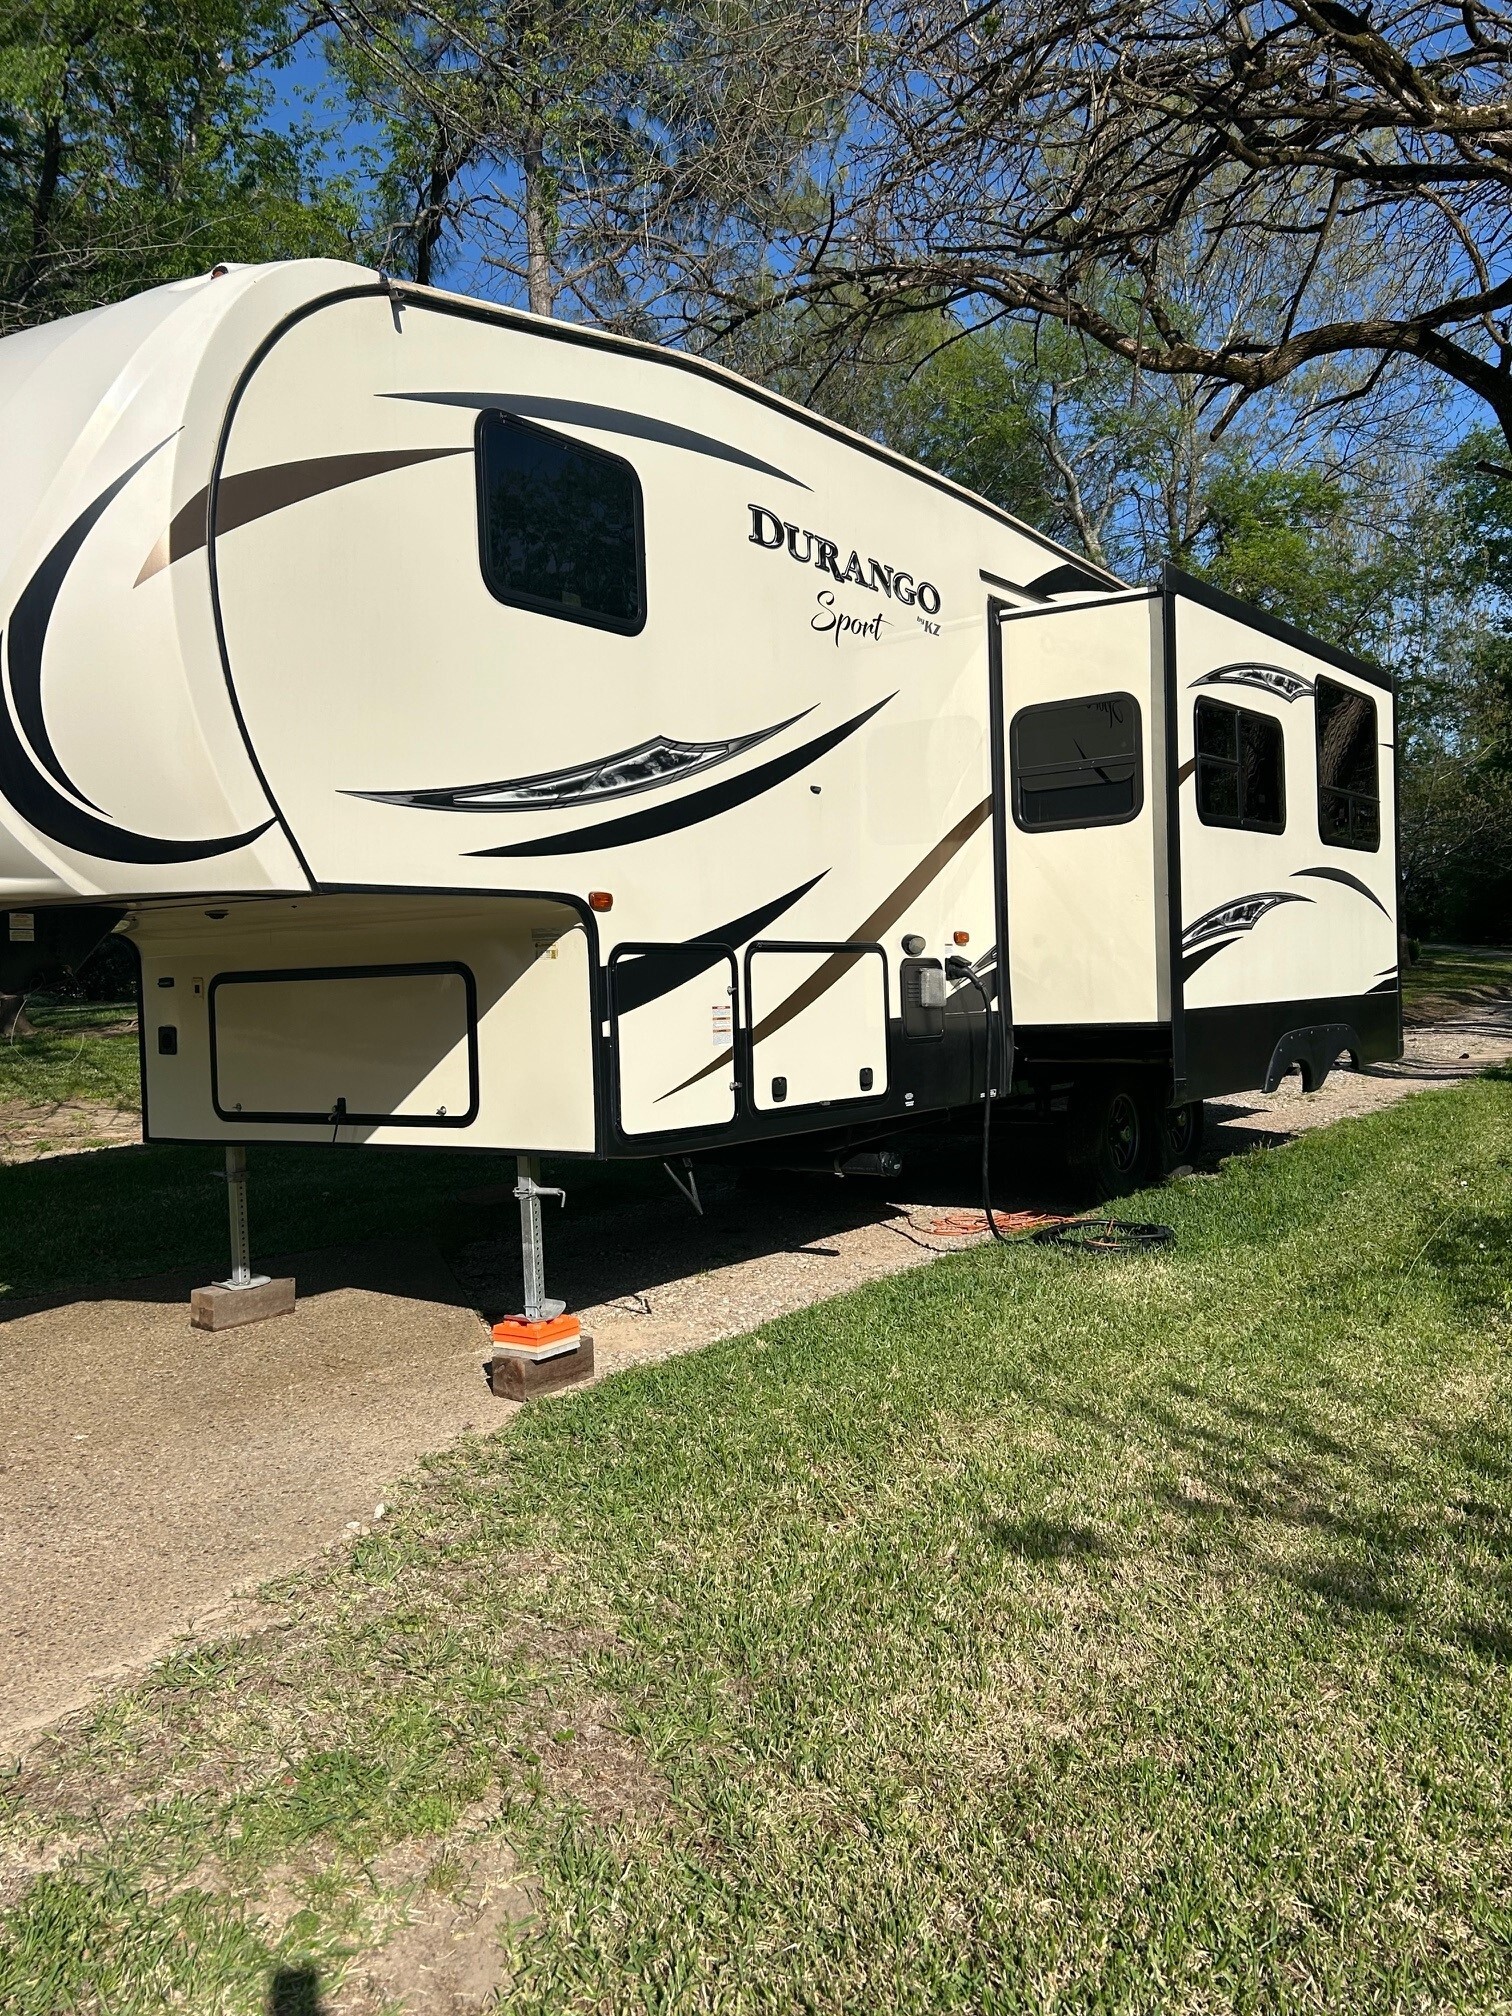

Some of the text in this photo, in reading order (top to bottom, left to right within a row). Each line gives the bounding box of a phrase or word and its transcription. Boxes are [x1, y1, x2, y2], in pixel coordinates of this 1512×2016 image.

[747, 503, 941, 615] DURANGO
[811, 590, 894, 648] Sport
[924, 620, 941, 636] KZ
